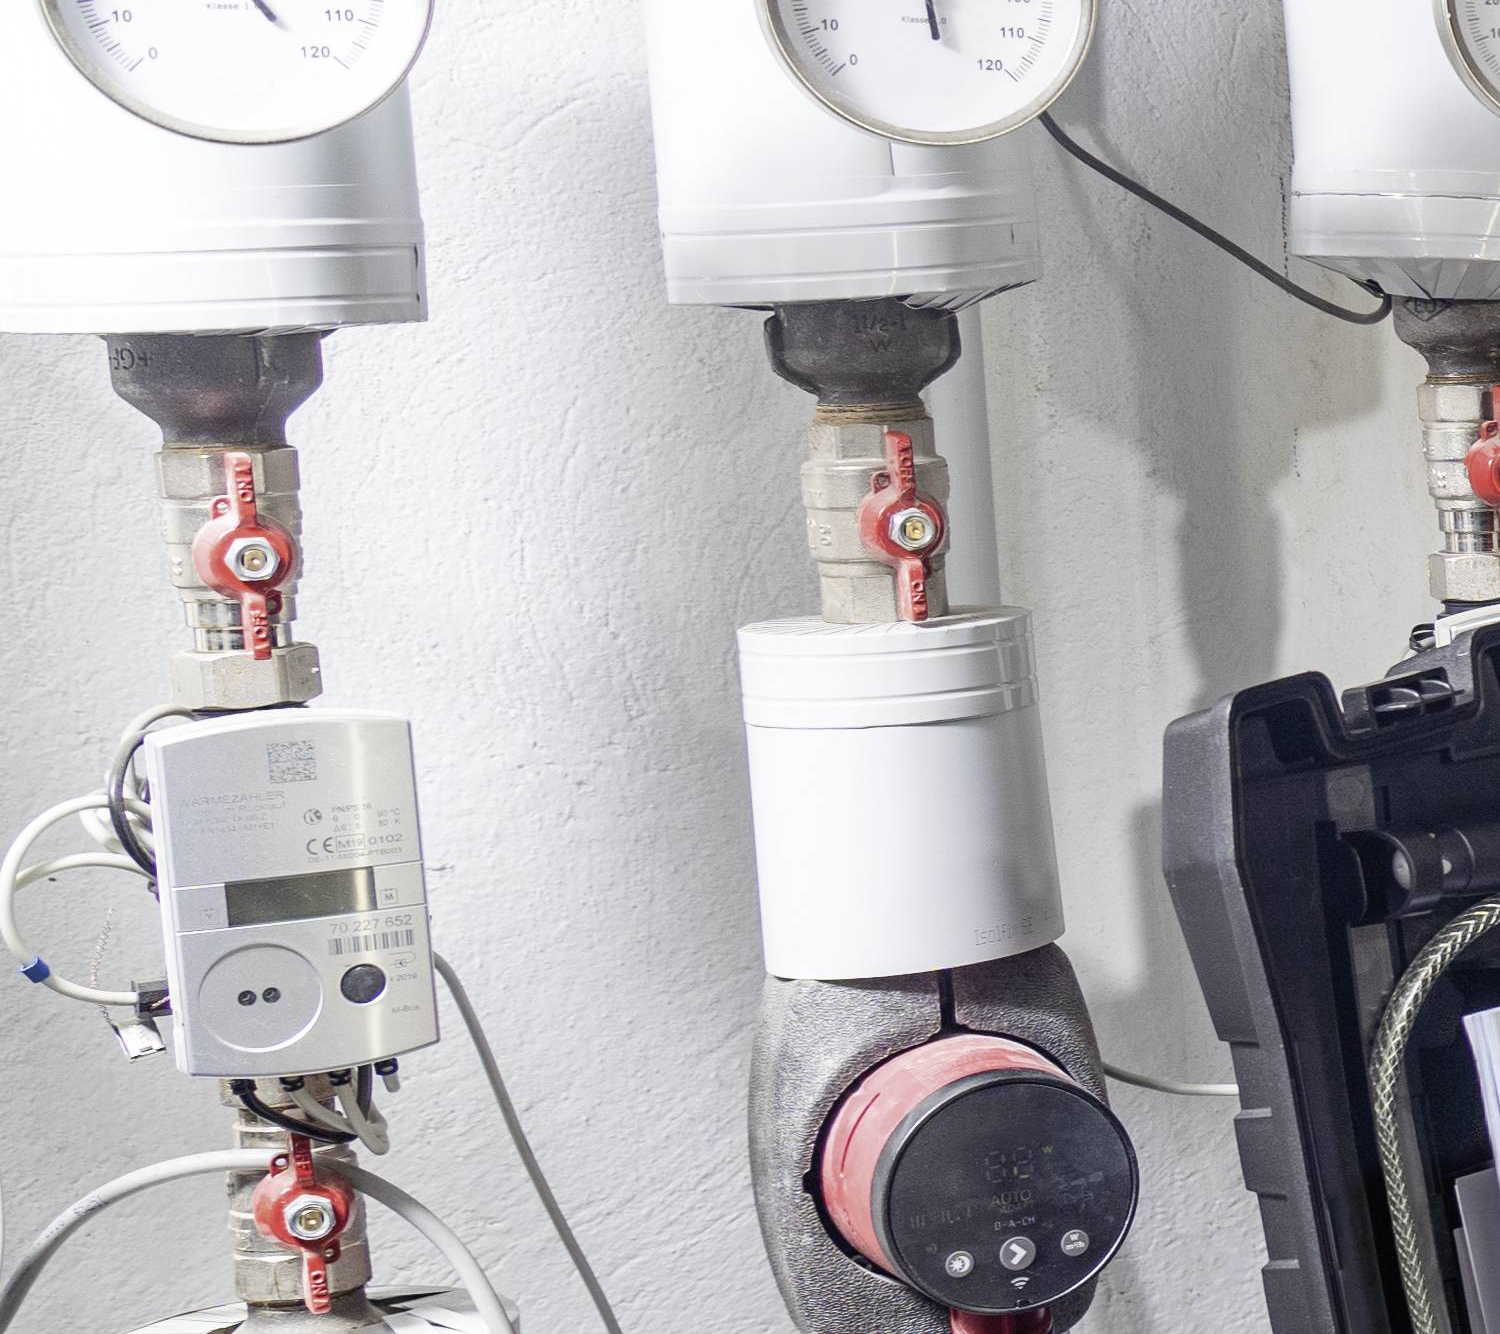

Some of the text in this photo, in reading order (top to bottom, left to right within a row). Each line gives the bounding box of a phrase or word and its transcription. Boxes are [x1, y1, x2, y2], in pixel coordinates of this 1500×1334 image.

[112, 10, 132, 22] 10
[324, 10, 354, 22] 110
[821, 19, 839, 31] 10
[1000, 27, 1025, 39] 110
[148, 47, 158, 59] 0
[300, 46, 330, 59] 120
[850, 54, 858, 66] 0
[977, 59, 1003, 71] 120
[368, 834, 405, 846] 0102
[330, 914, 413, 935] 70 227 652
